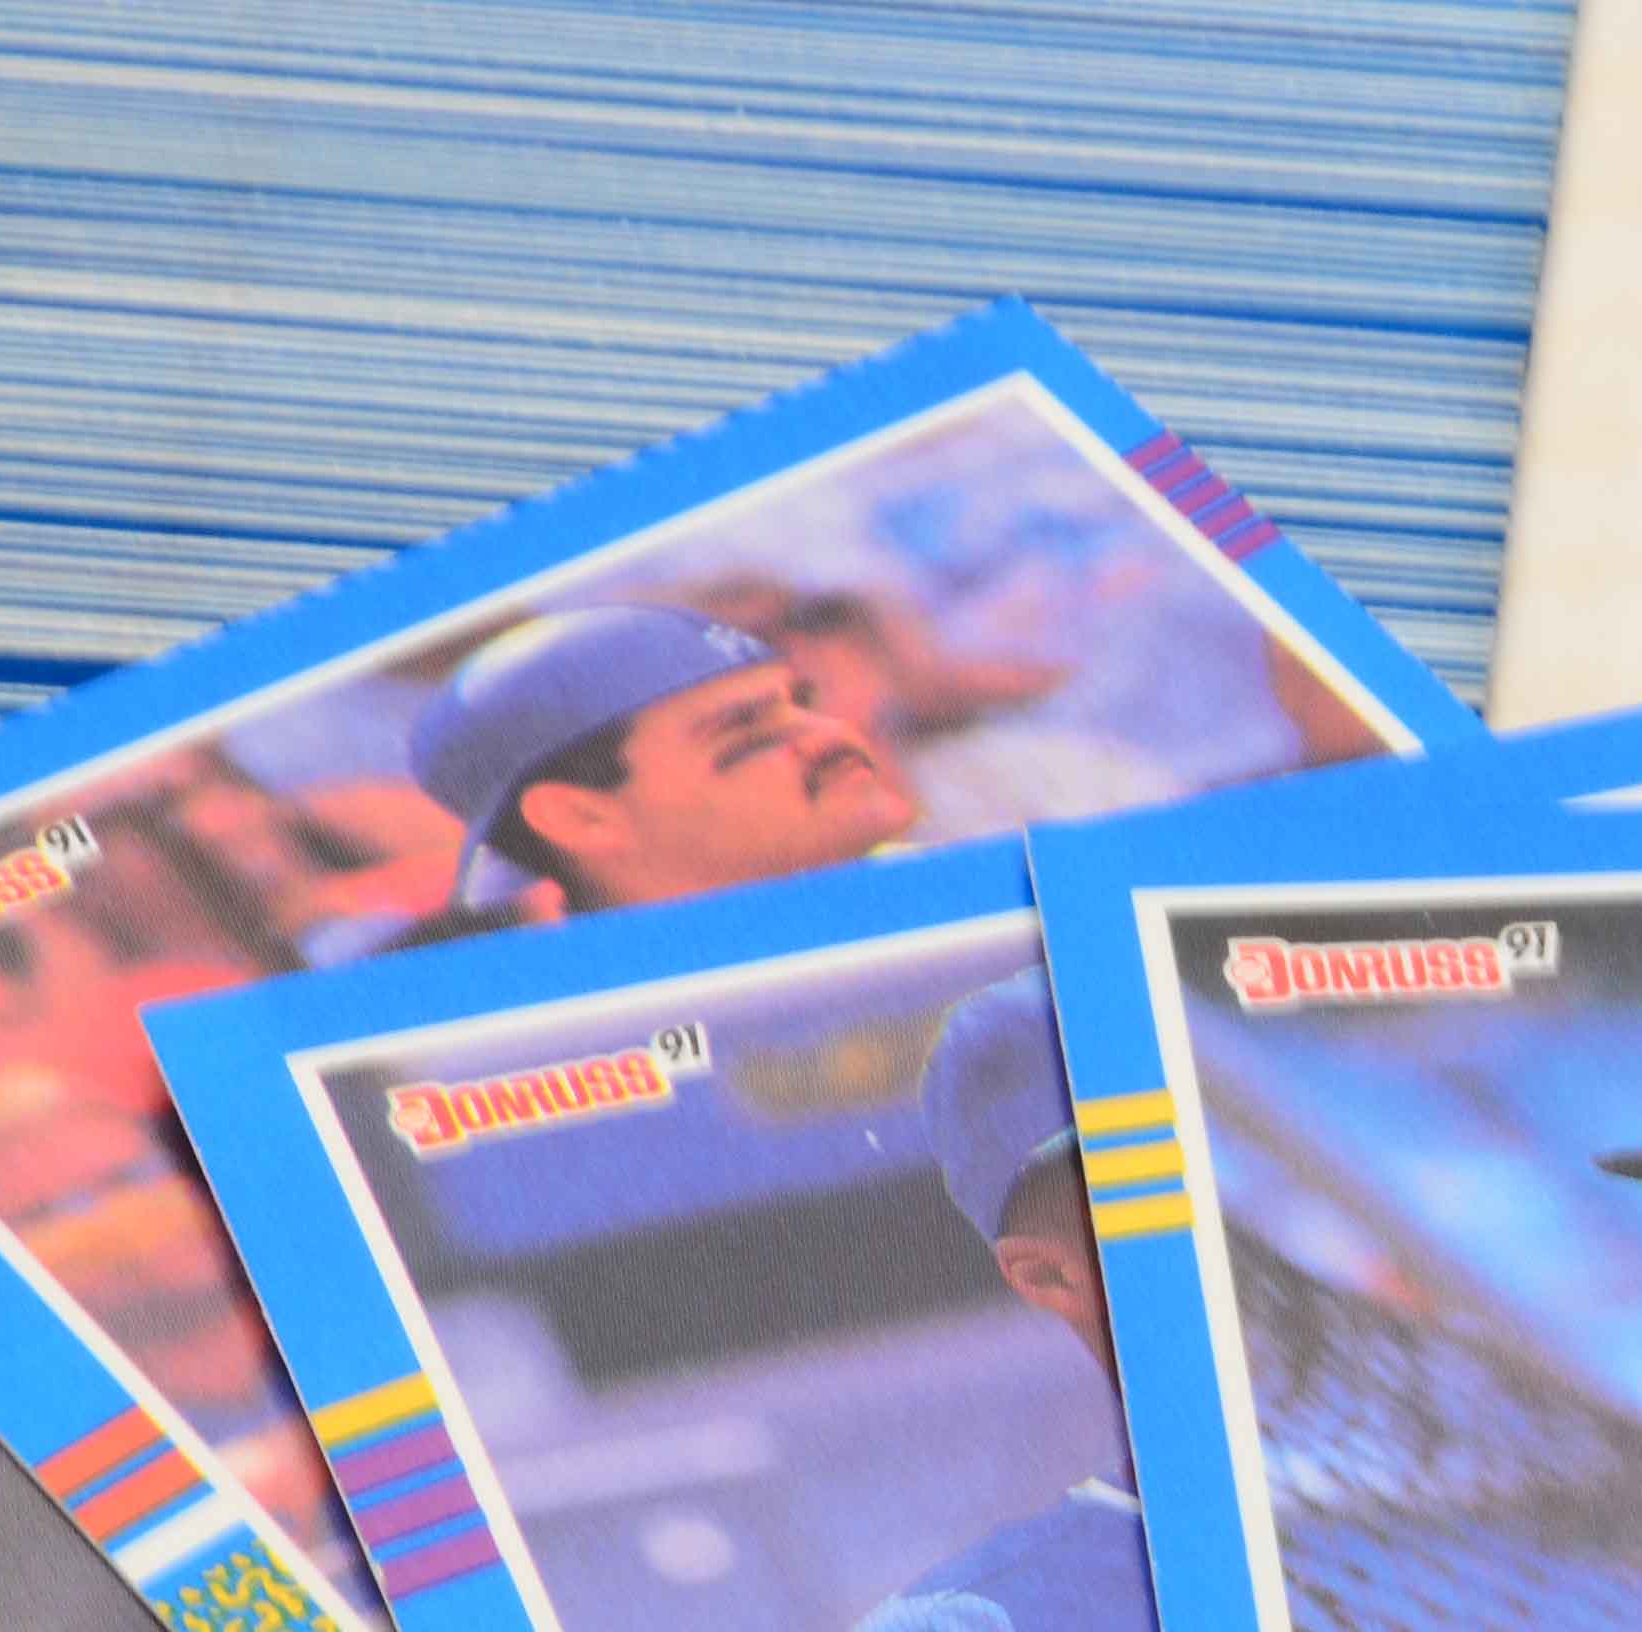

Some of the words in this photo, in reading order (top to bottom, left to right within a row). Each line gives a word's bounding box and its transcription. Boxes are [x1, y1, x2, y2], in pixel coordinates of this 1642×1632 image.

[1227, 936, 1509, 1008] DONRUSS
[1505, 924, 1551, 960] 91
[390, 1049, 671, 1156] DONRUSS
[657, 1022, 707, 1062] 91
